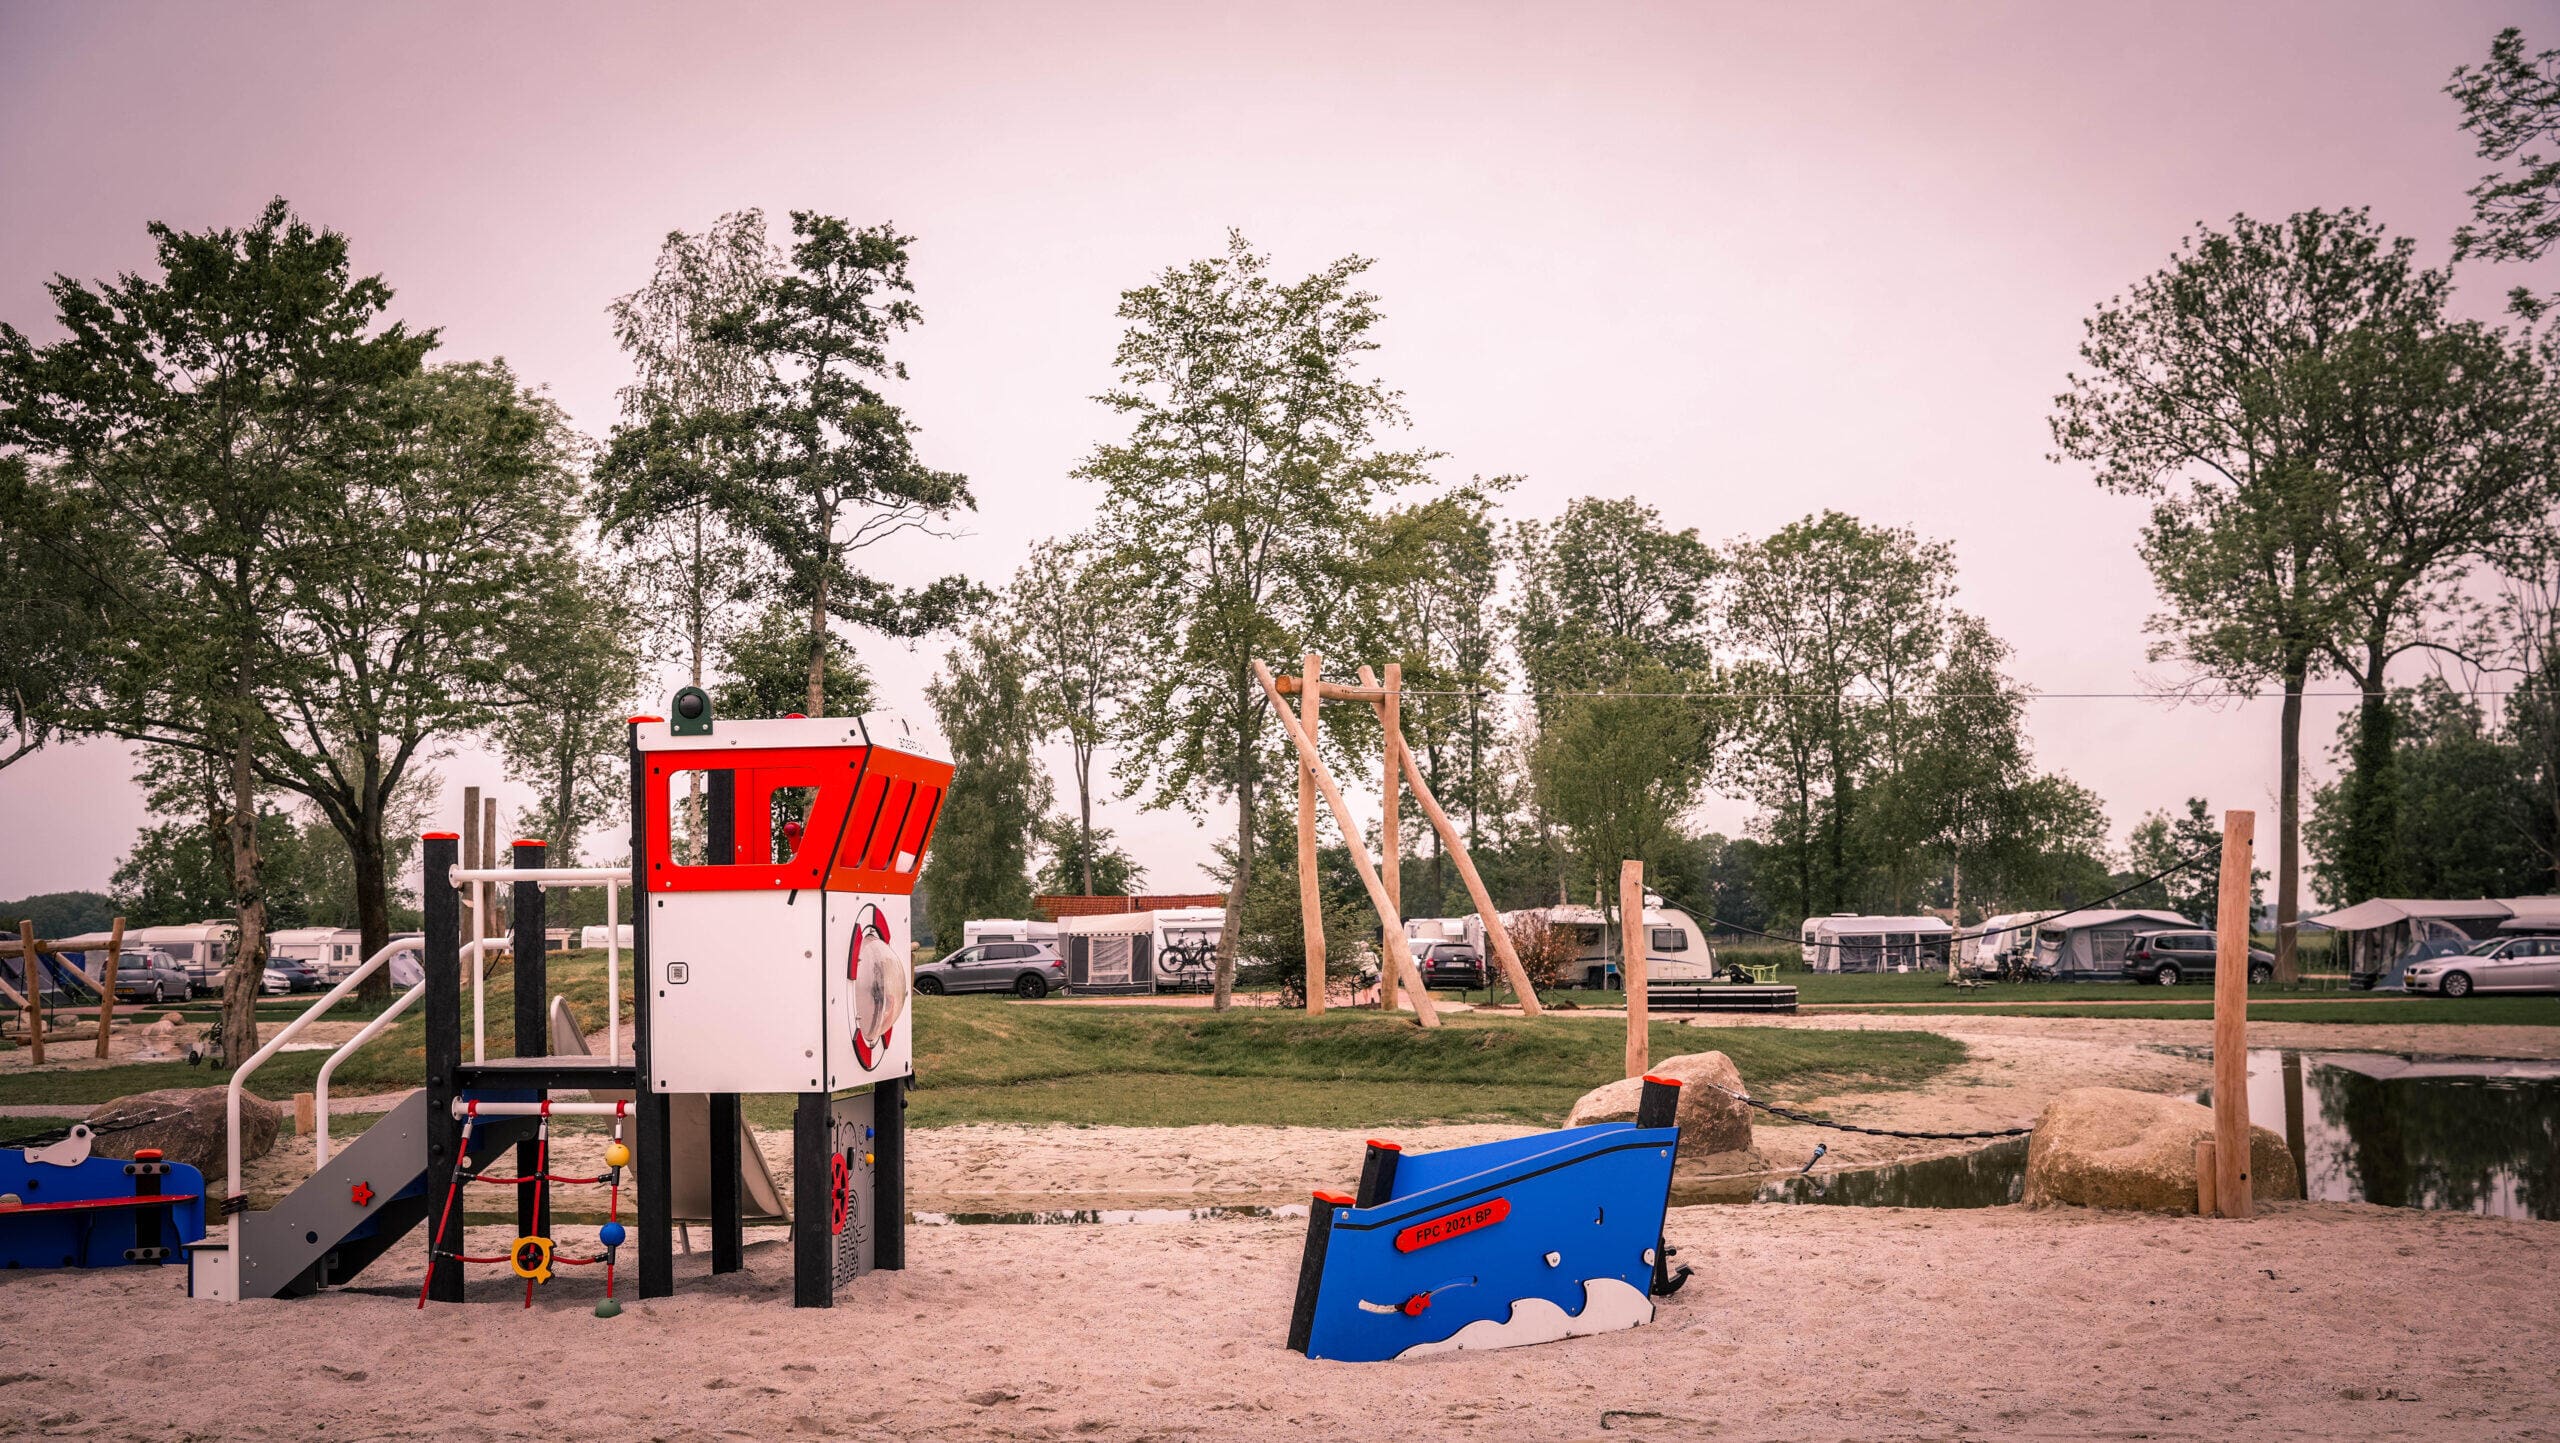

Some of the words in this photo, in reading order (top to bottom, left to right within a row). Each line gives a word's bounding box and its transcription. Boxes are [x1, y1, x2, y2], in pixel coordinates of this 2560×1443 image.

[1416, 1225, 1440, 1243] FPC
[1445, 1215, 1472, 1233] 2021
[1475, 1208, 1492, 1224] BP
